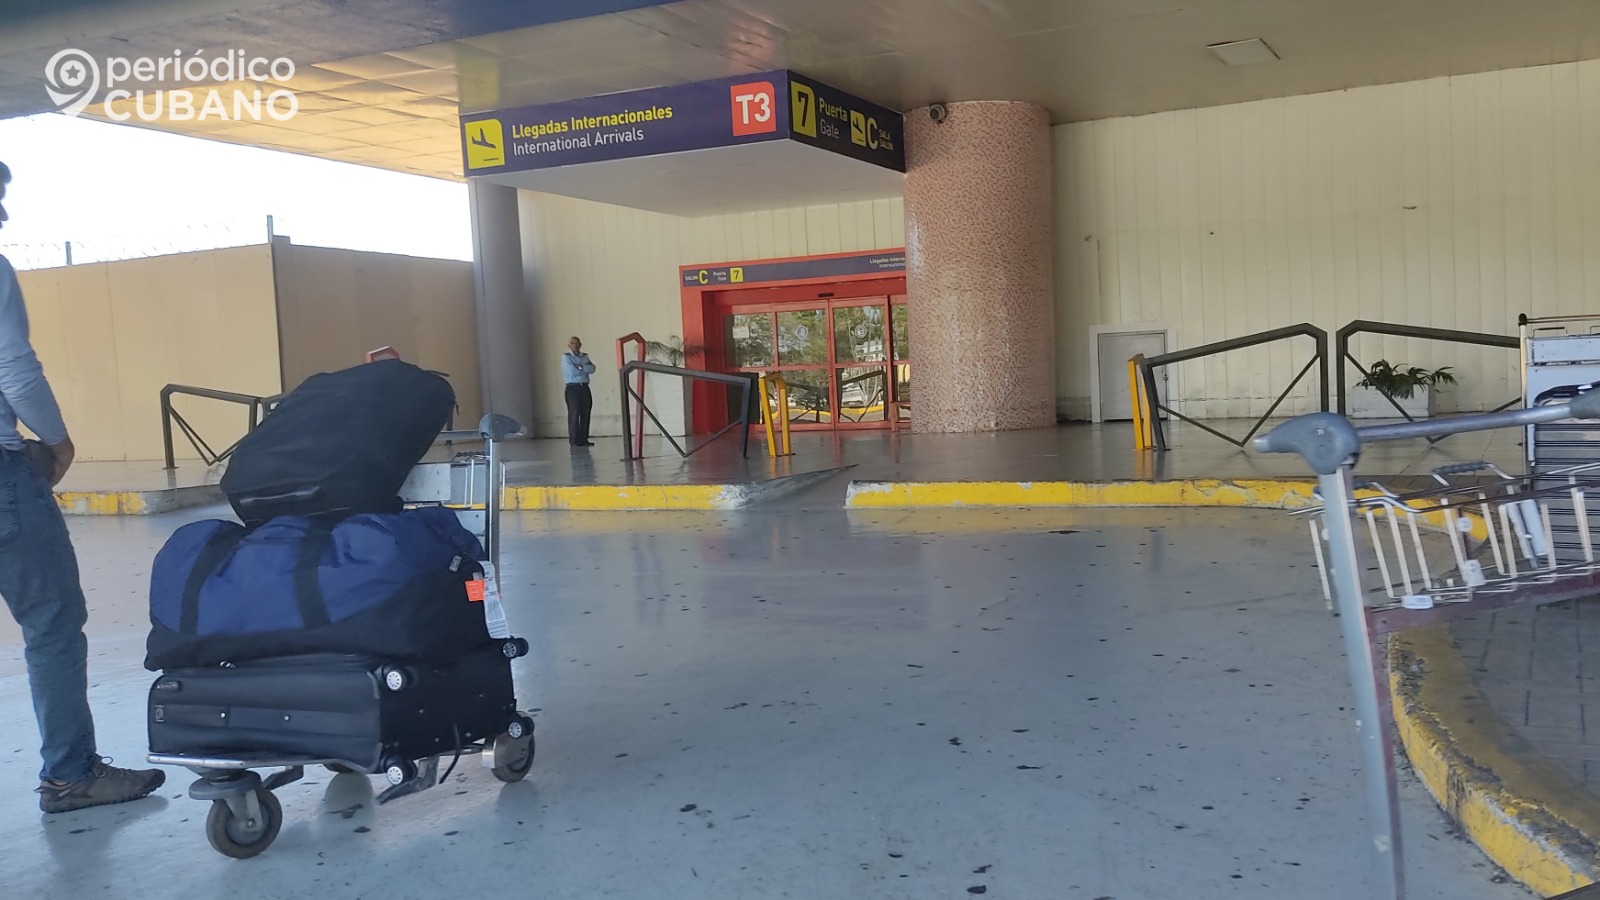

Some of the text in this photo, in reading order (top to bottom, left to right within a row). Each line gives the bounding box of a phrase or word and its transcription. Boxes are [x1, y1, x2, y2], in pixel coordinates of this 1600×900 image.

[512, 105, 673, 140] Llegadas Internacionales
[735, 92, 771, 125] T3
[797, 90, 809, 128] 7
[819, 97, 848, 122] Puerta
[513, 127, 644, 156] International Arrivals
[820, 118, 840, 139] Gate
[867, 117, 878, 150] C
[699, 269, 708, 285] C
[733, 270, 739, 281] 7
